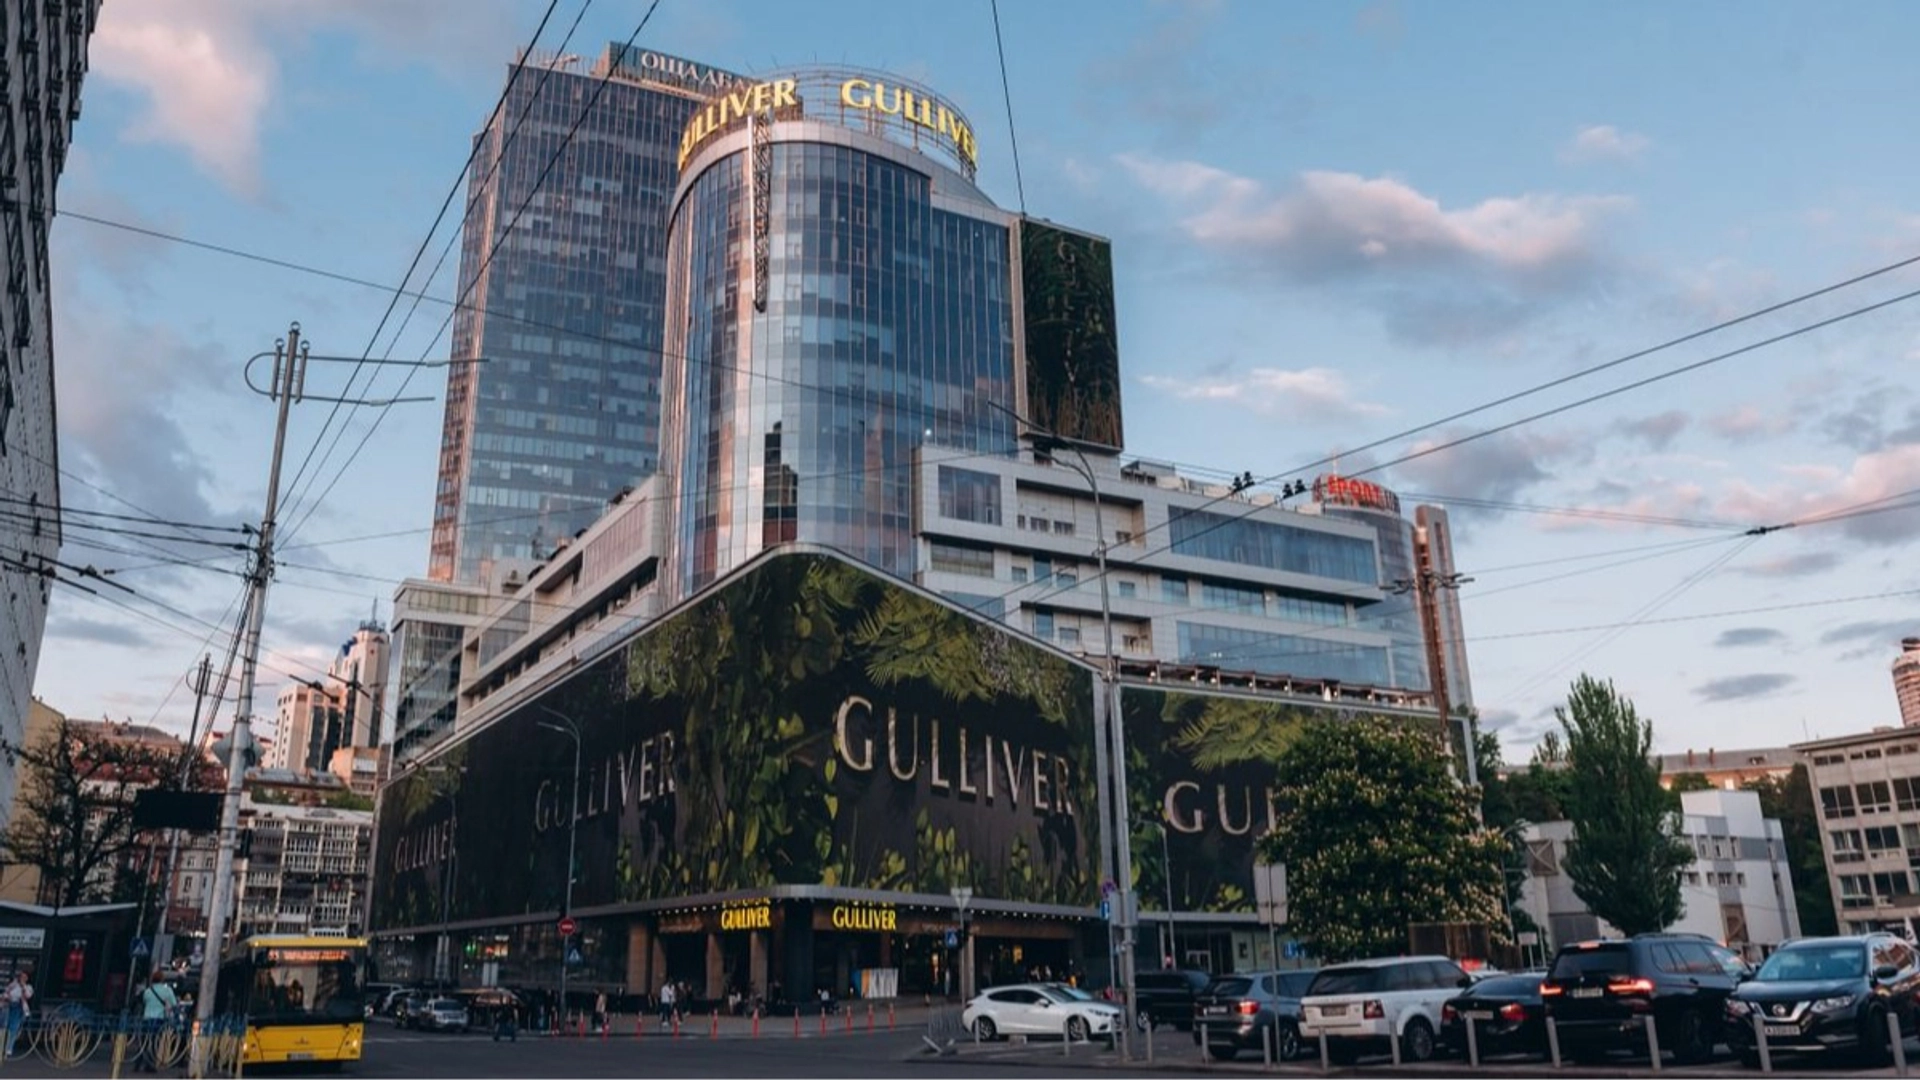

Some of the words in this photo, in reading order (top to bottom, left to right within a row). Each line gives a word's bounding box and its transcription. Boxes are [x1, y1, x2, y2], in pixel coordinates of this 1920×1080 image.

[836, 696, 1075, 815] GULLIVER
[721, 906, 772, 931] GULLIVER
[832, 905, 897, 931] GULLIVER
